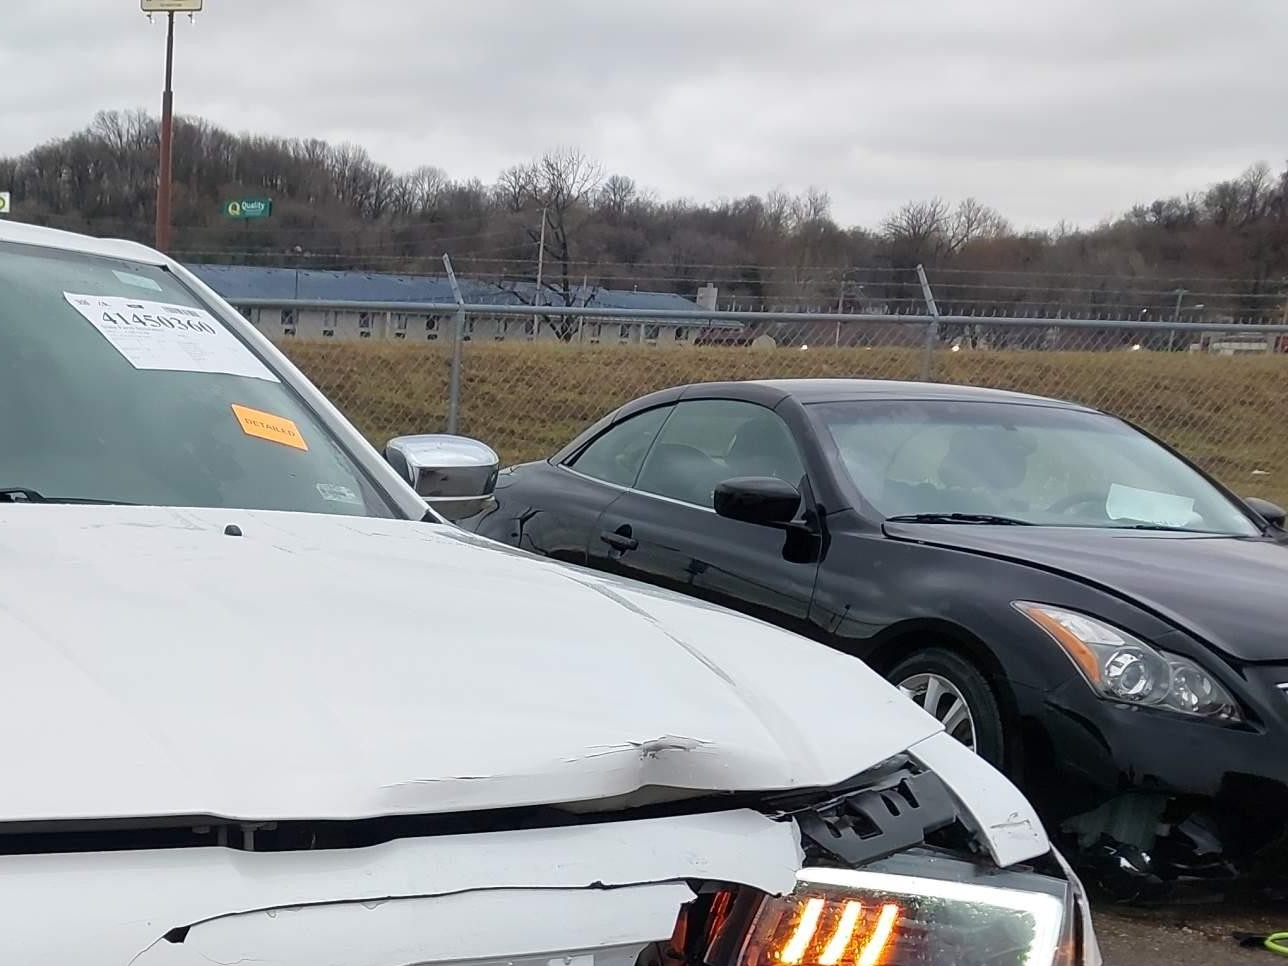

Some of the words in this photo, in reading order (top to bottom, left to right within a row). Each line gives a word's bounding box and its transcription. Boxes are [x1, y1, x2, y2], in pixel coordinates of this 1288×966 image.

[241, 200, 264, 210] Quality
[102, 311, 216, 335] 41450360
[244, 417, 296, 437] DETAILED
